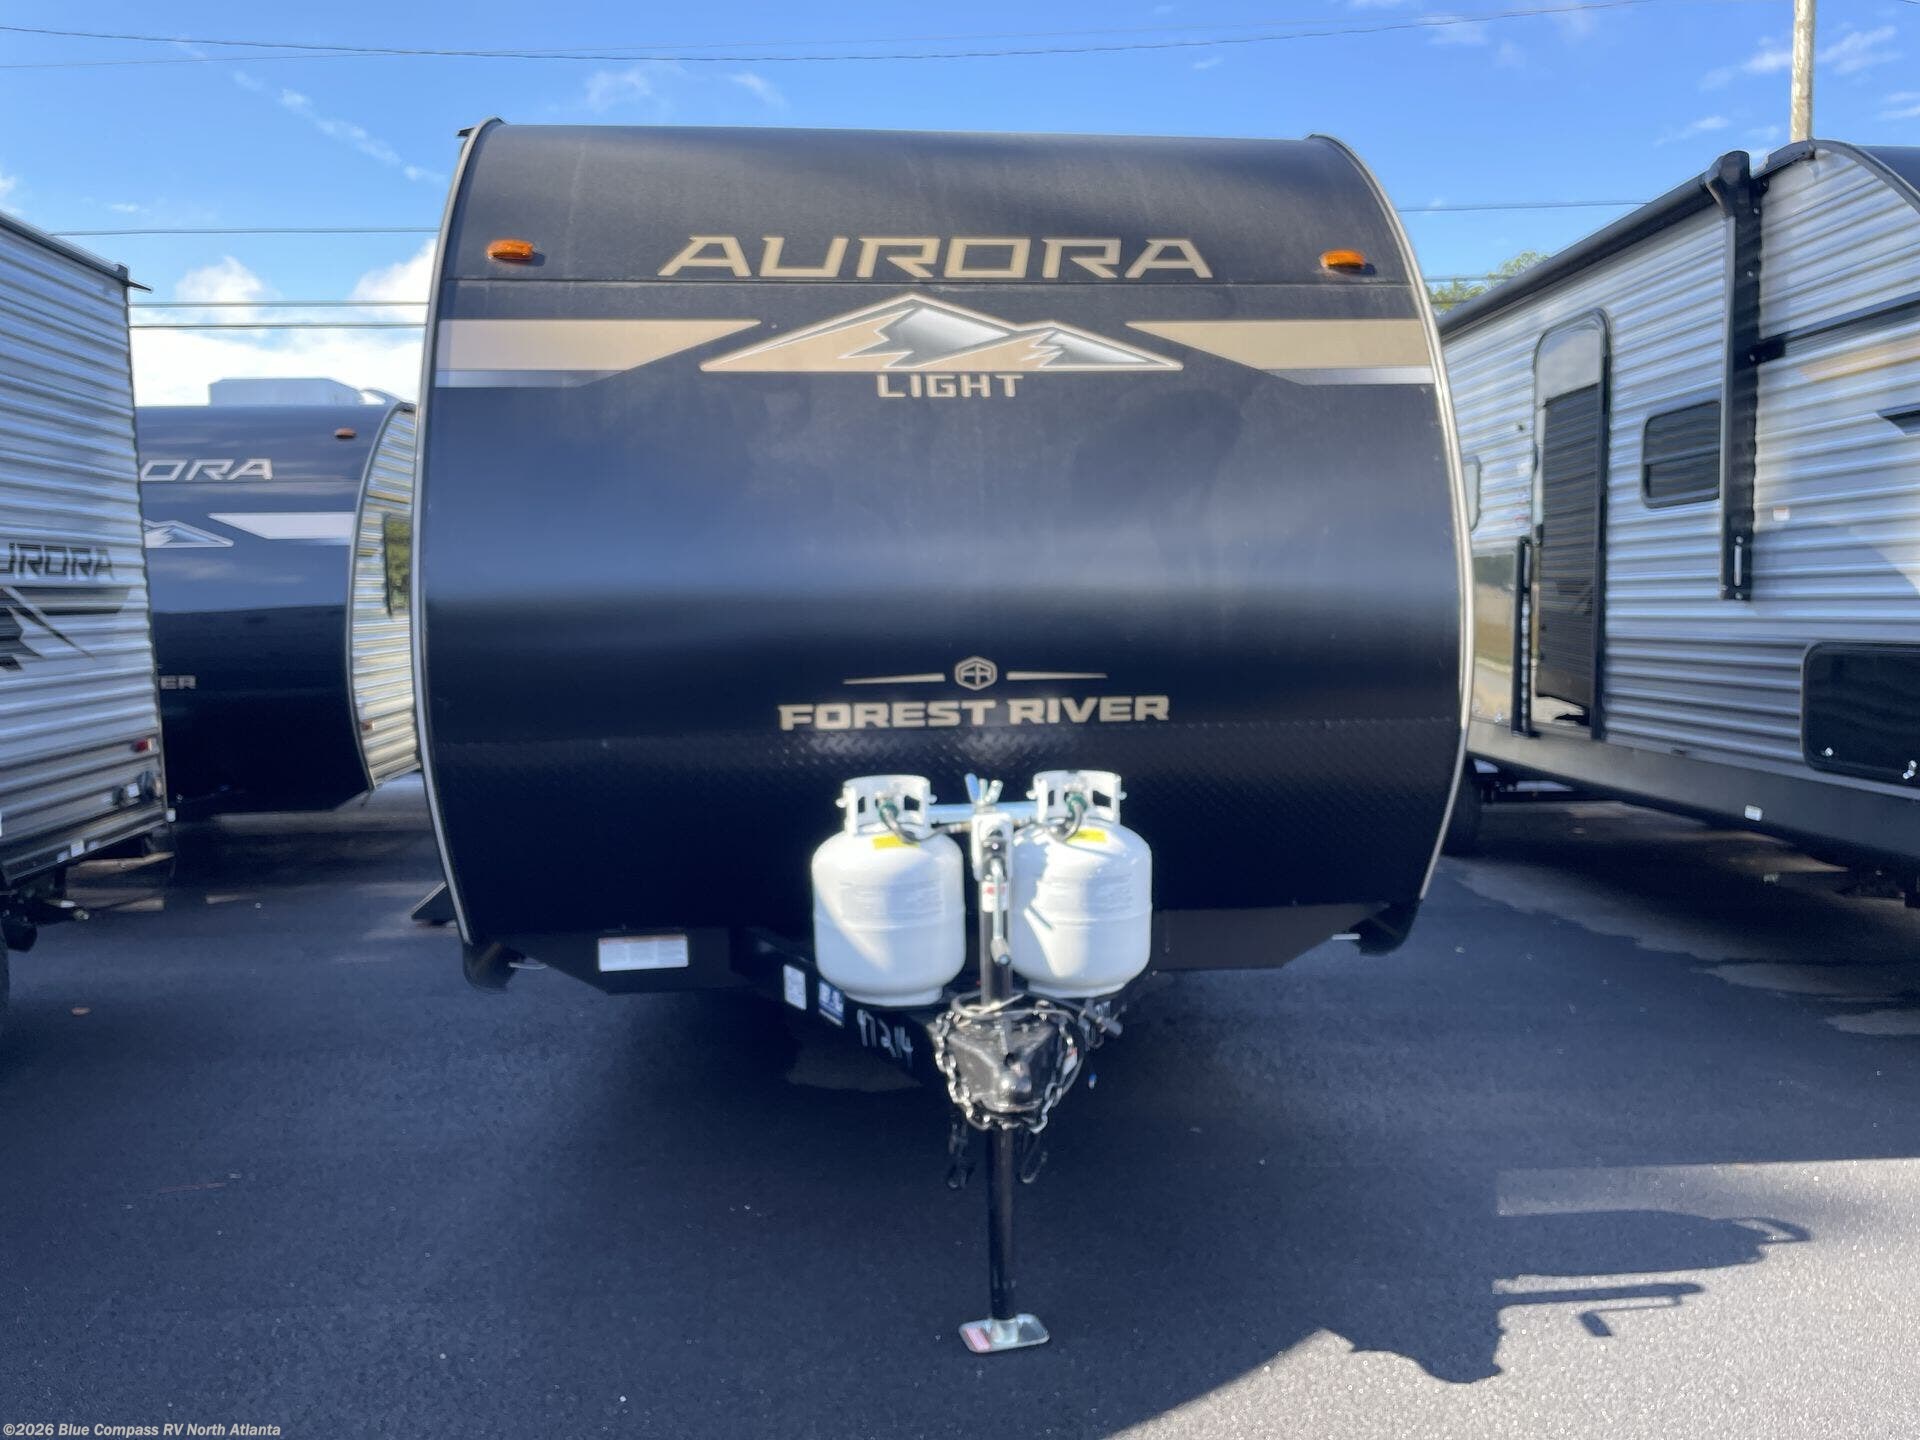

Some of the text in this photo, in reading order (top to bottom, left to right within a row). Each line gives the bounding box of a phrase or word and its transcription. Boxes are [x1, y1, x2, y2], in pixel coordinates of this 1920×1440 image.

[657, 236, 1214, 279] AURORA
[876, 374, 1023, 399] LIGHT
[778, 694, 1169, 731] FOREST RIVER
